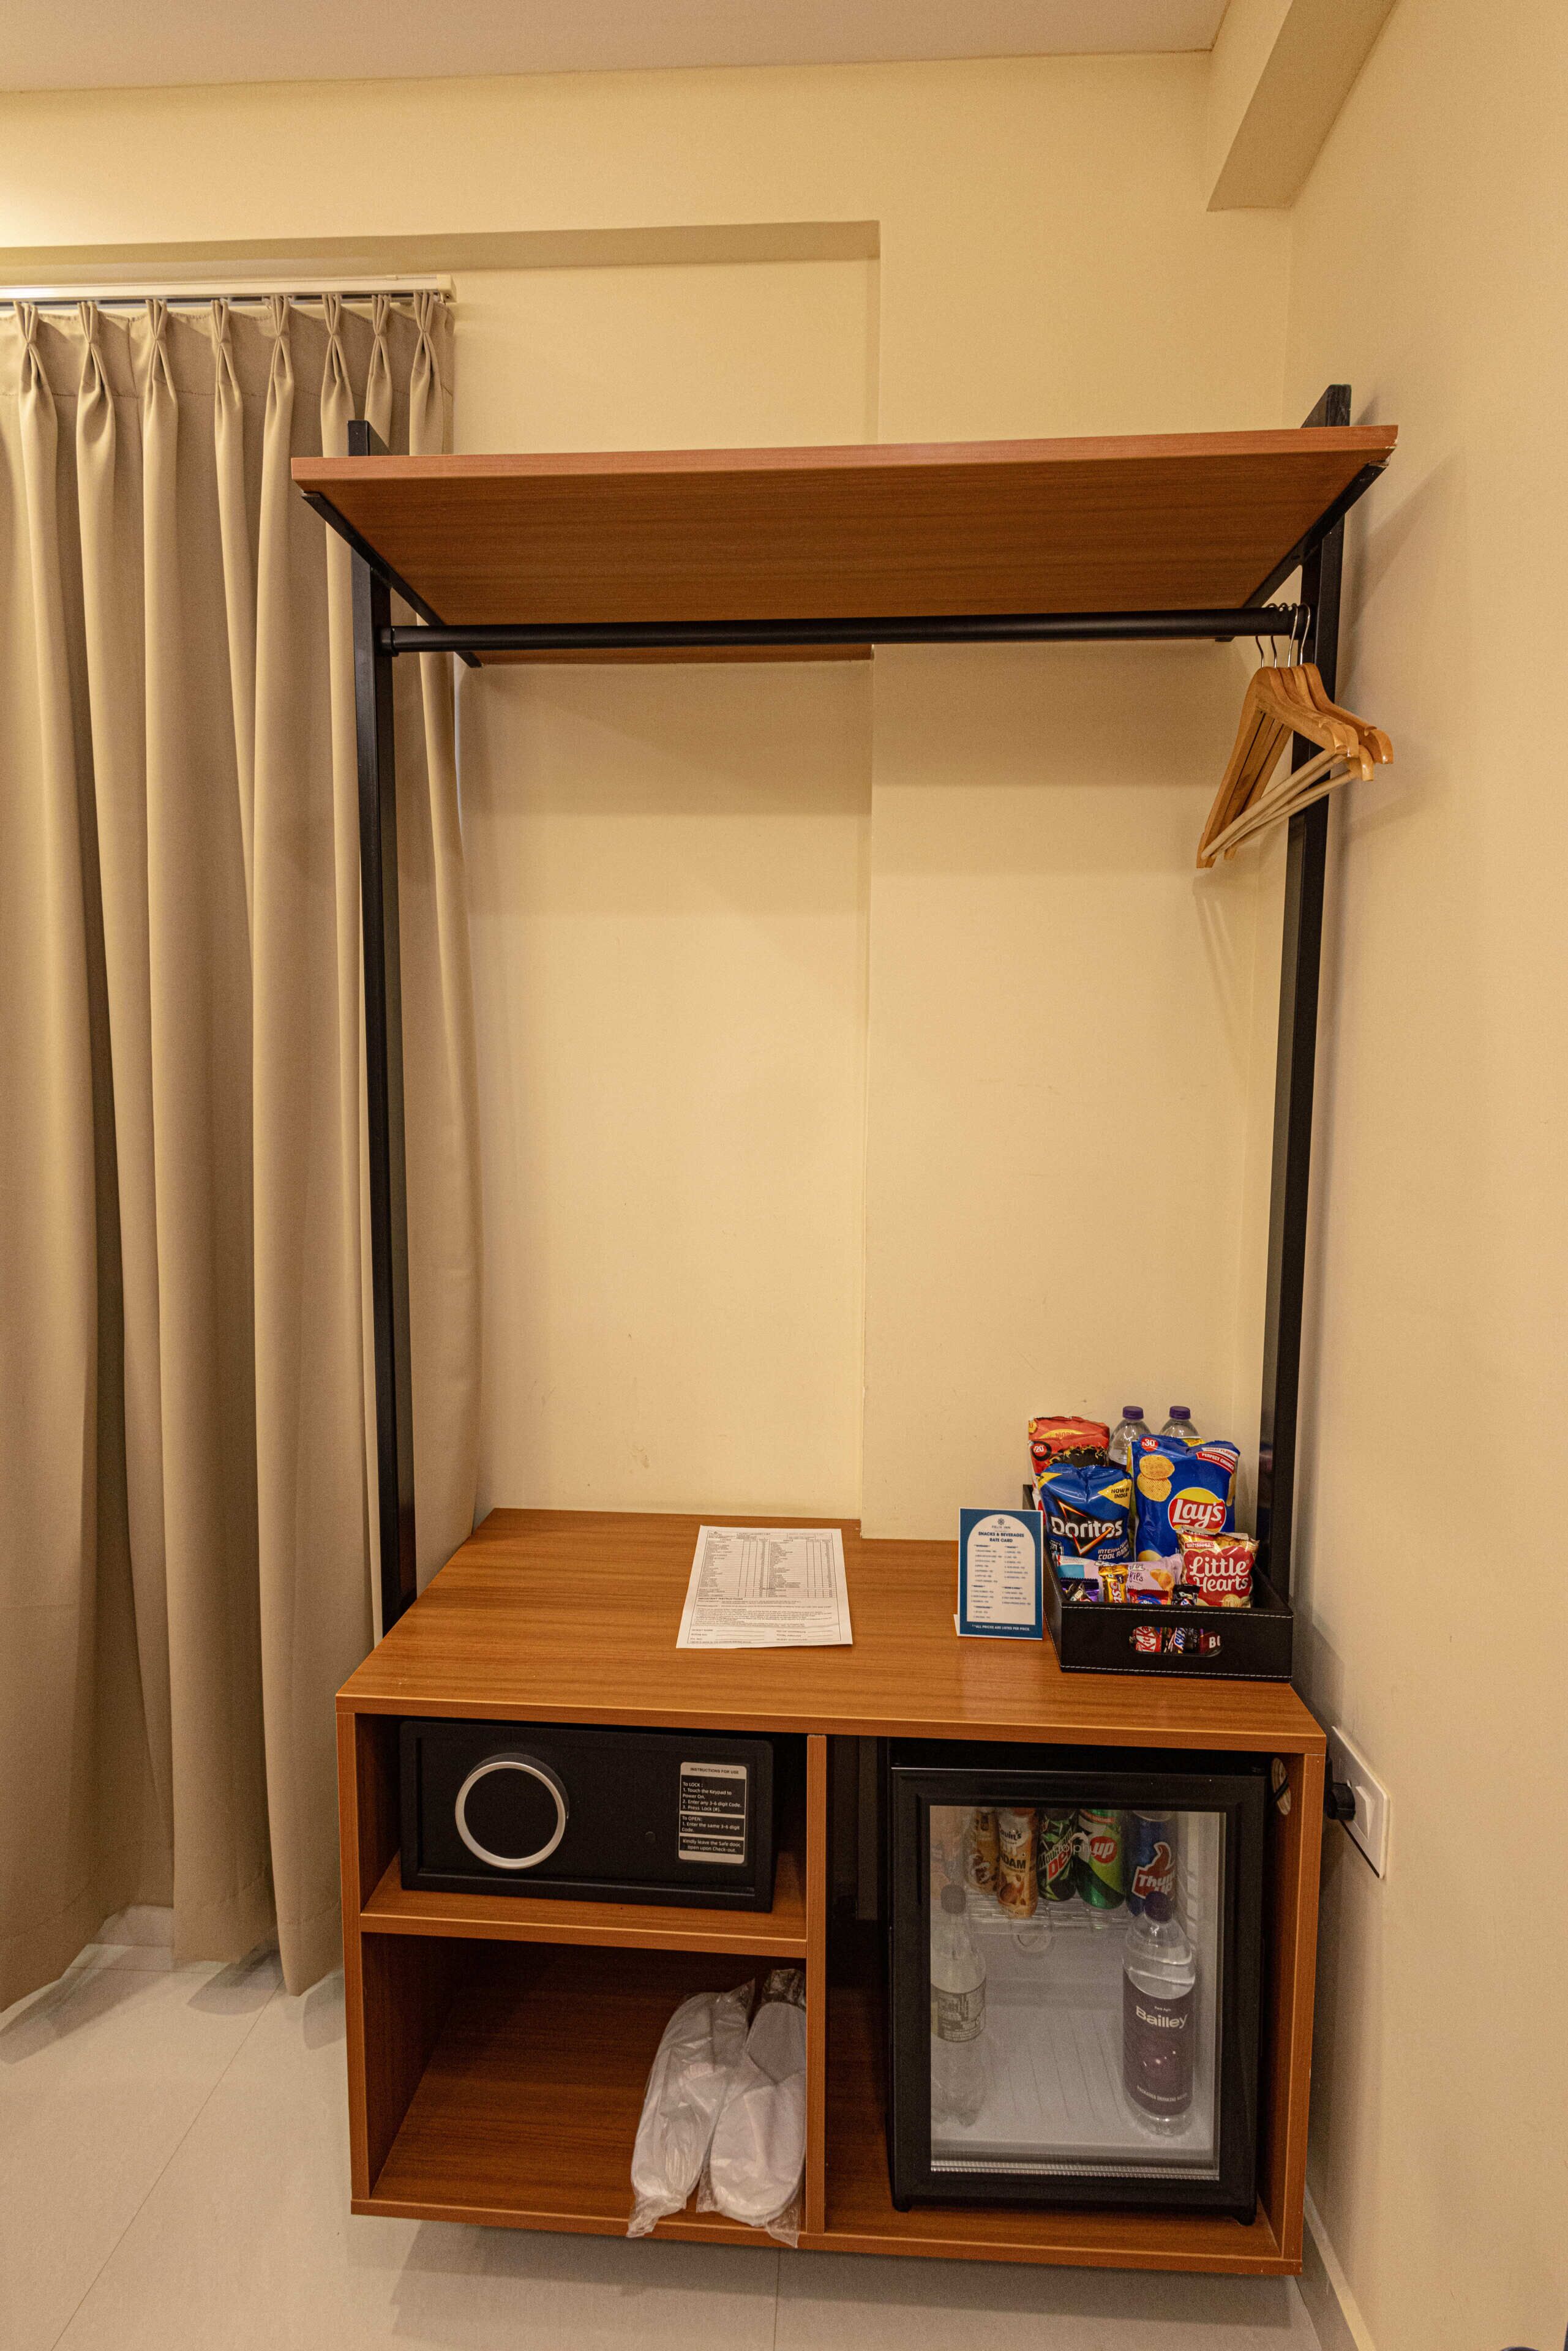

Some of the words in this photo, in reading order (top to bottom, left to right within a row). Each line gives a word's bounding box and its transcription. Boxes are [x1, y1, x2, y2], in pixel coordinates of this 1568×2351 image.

[1172, 1499, 1223, 1528] Lay's
[1051, 1517, 1123, 1538] Doritos
[1189, 1556, 1249, 1578] Little
[1194, 1575, 1248, 1593] Hearts
[1136, 2005, 1188, 2029] Bailley
